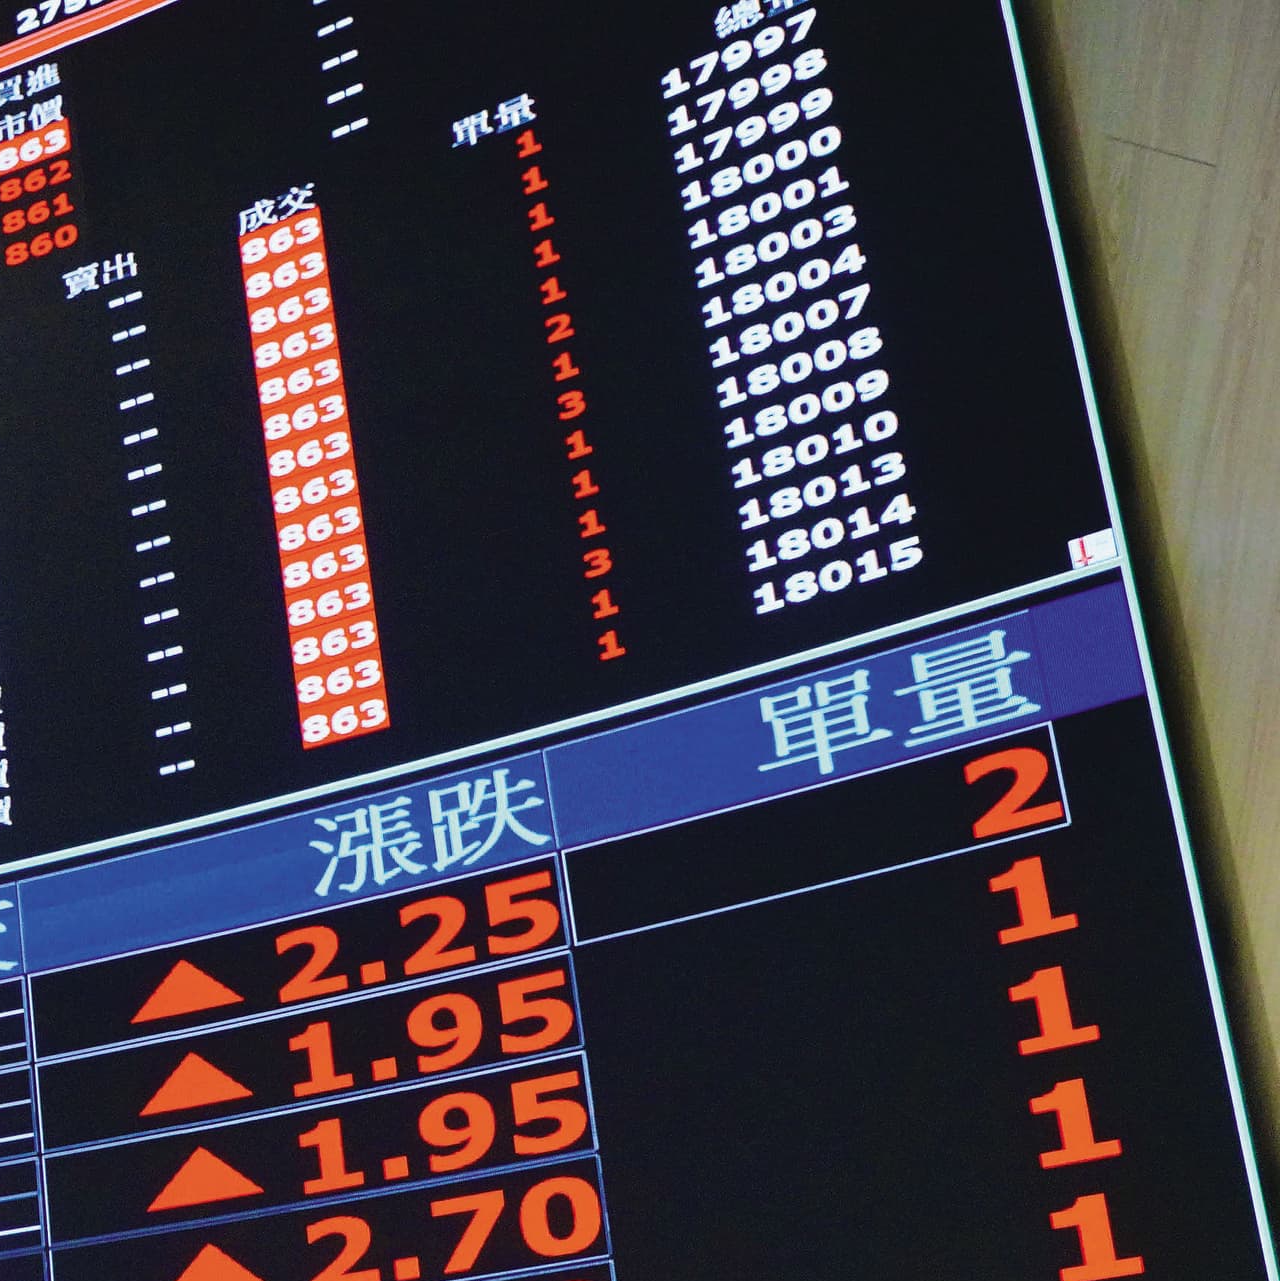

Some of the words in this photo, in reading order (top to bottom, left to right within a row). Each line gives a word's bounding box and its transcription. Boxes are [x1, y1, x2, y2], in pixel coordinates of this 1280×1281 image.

[662, 8, 816, 98] 17997
[452, 94, 536, 147] 單量
[6, 224, 77, 265] 860
[239, 183, 315, 236] 成交
[242, 218, 320, 264] 863
[62, 253, 137, 299] 賣出
[710, 284, 870, 371] 18007
[265, 395, 344, 440] 863
[558, 391, 585, 419] 3
[754, 536, 922, 614] 18015
[758, 630, 1041, 774] 單量
[309, 769, 551, 896] 漲跌
[964, 748, 1063, 838] 2
[276, 871, 559, 1003] 2.25
[990, 856, 1078, 944] 1
[289, 961, 573, 1097] 1.95
[295, 1066, 580, 1202] 1.95
